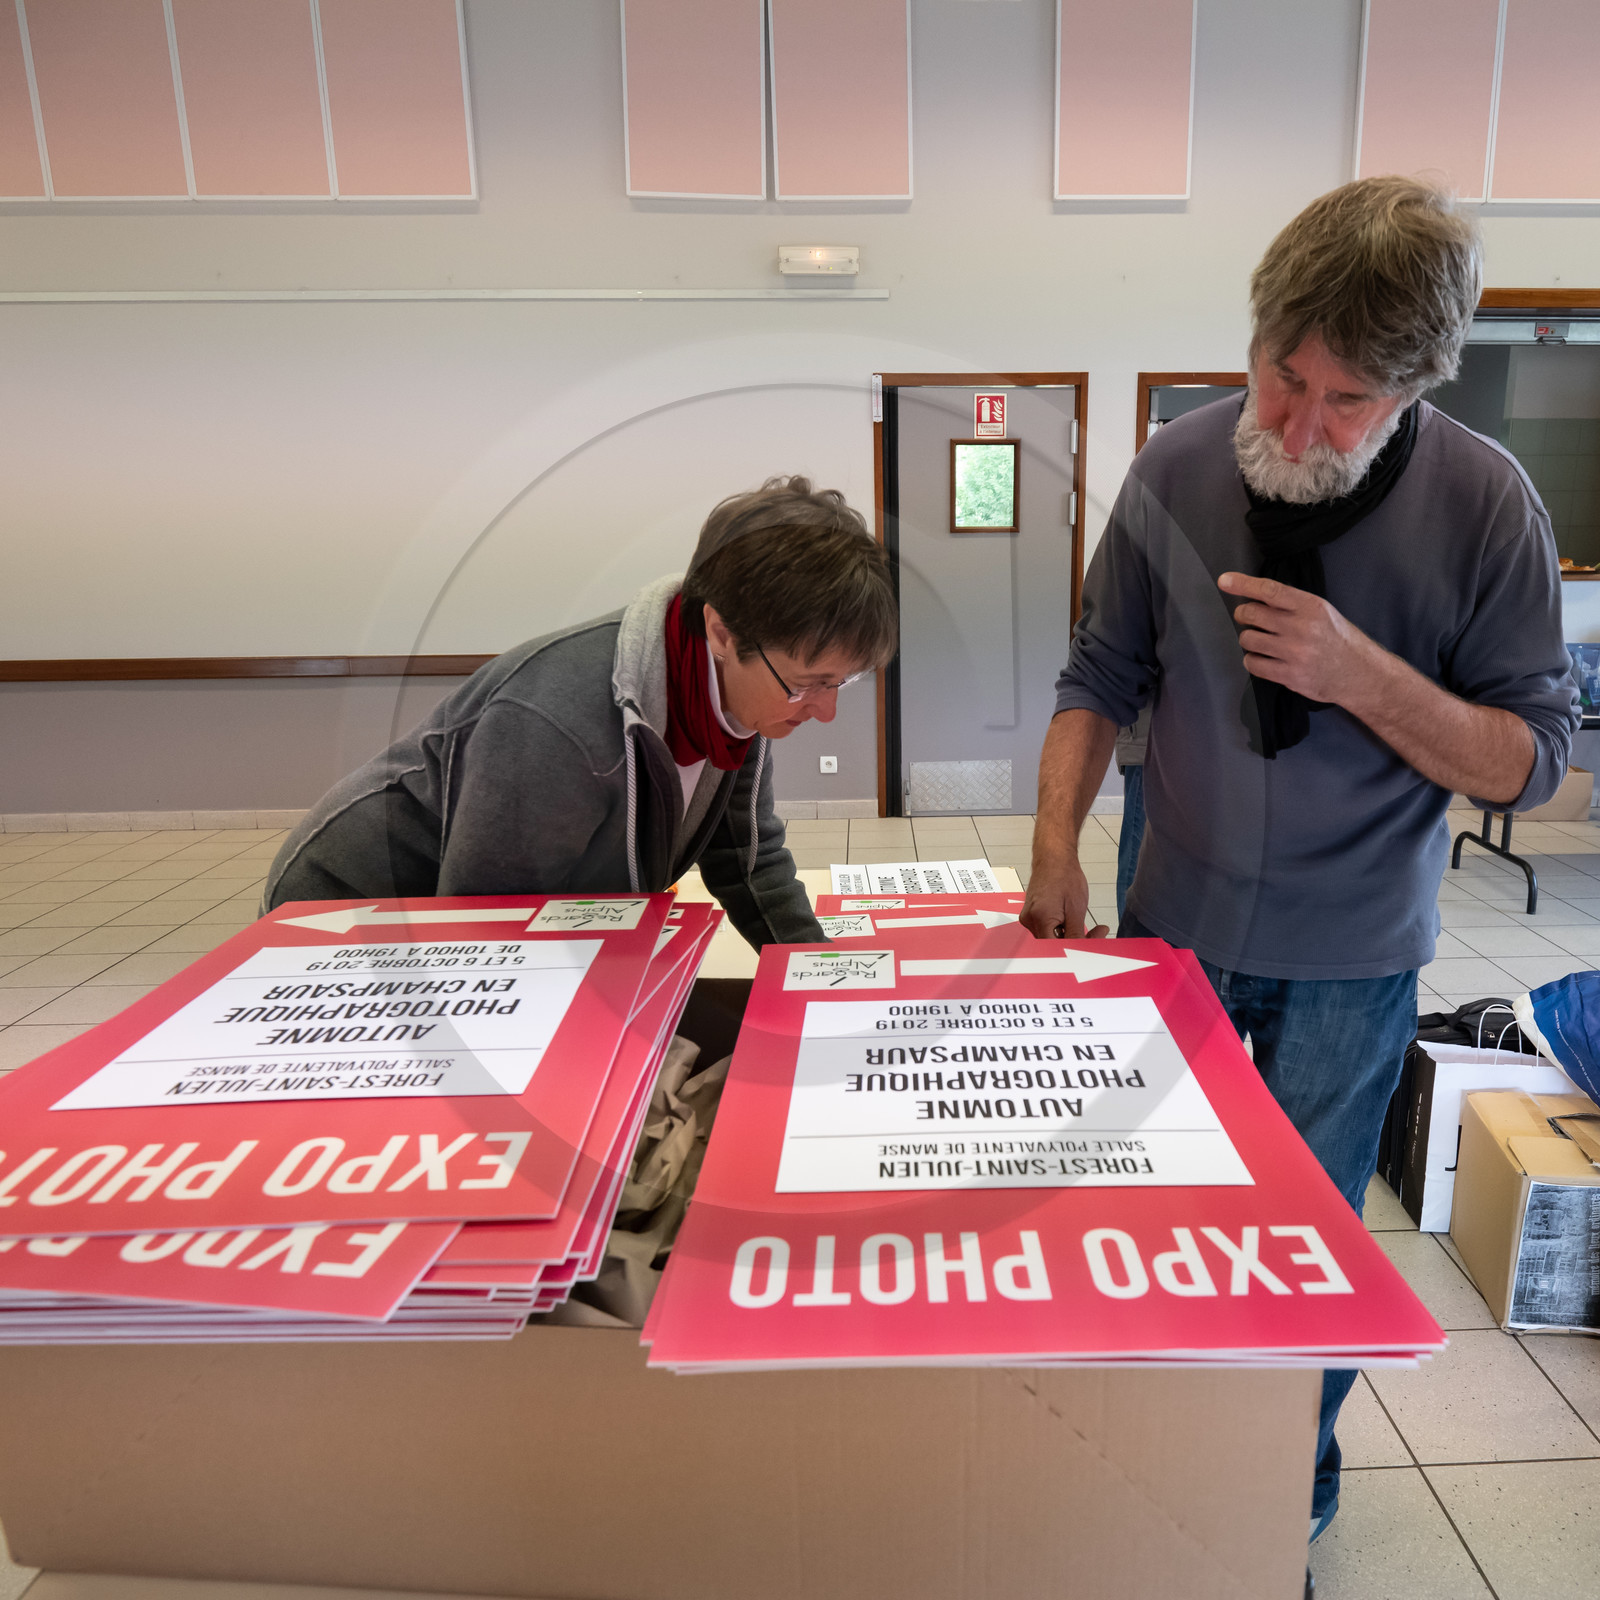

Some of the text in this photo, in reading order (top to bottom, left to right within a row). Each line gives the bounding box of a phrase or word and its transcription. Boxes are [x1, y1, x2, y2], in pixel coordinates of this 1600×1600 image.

[333, 945, 521, 958] DE 10H00 À 19H00
[305, 956, 526, 972] 5 ET 6 OCTOBRE 2019
[262, 979, 517, 1002] EN CHAMPSAUR
[213, 998, 521, 1025] PHOTOGRAPHIQUE
[888, 1003, 1075, 1017] DE 10H00 À 19H00
[876, 1017, 1093, 1030] 5 ET 6 OCTOBRE 2019
[256, 1024, 436, 1046] AUTOMNE
[866, 1045, 1115, 1065] EN CHAMPSAUR
[190, 1059, 454, 1076] SALLE POLYVALENTE DE MANSE
[166, 1073, 446, 1098] FOREST-SAINT-JULIEN
[845, 1069, 1146, 1092] PHOTOGRAPHIQUE
[916, 1098, 1082, 1119] AUTOMNE
[878, 1141, 1146, 1156] SALLE POLYVALENTE DE MANSE
[0, 1131, 533, 1207] EXPO PHOT
[880, 1158, 1154, 1178] FOREST-SAINT-JULIEN
[729, 1225, 1355, 1309] EXPO PHOTO
